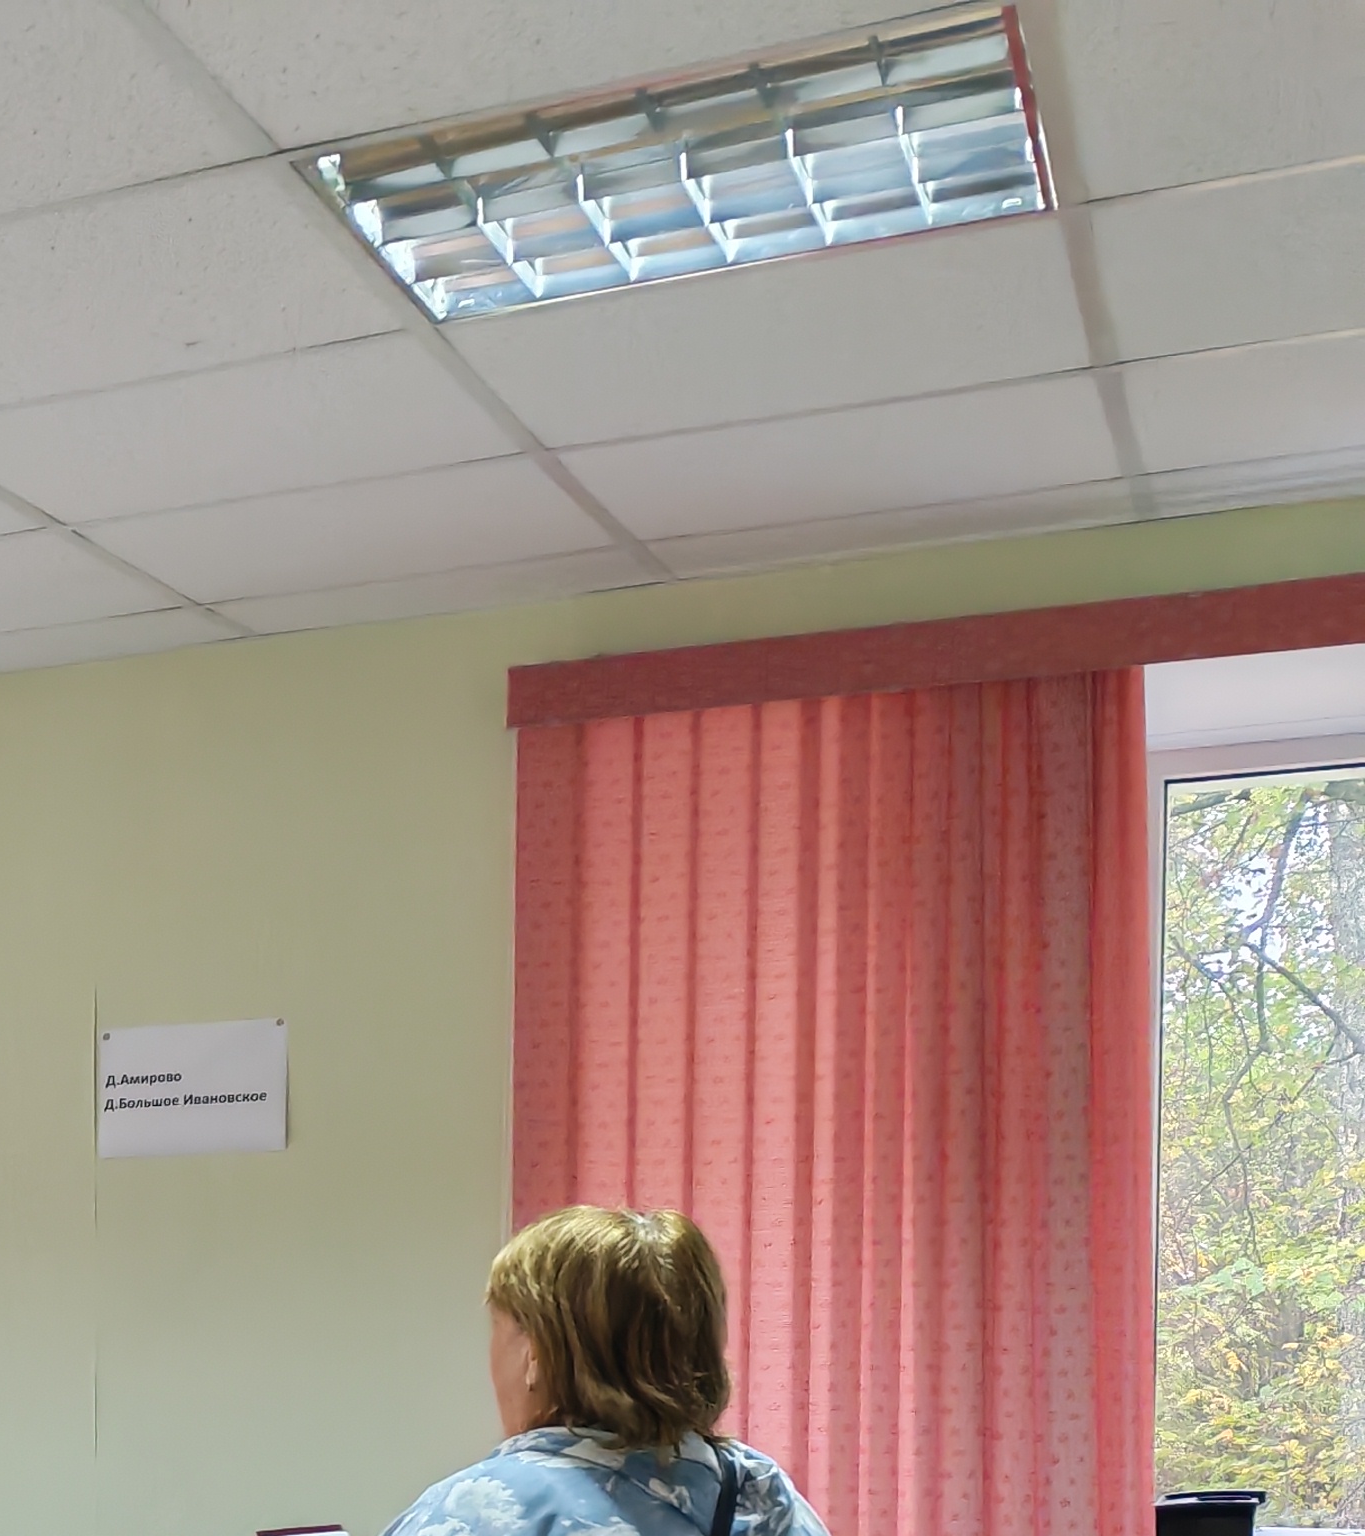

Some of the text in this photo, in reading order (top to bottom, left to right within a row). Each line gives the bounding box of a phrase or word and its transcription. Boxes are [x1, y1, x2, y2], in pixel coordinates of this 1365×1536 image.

[105, 1072, 182, 1088] Д.Амирово
[104, 1091, 267, 1113] Д.Большое Ивановское
